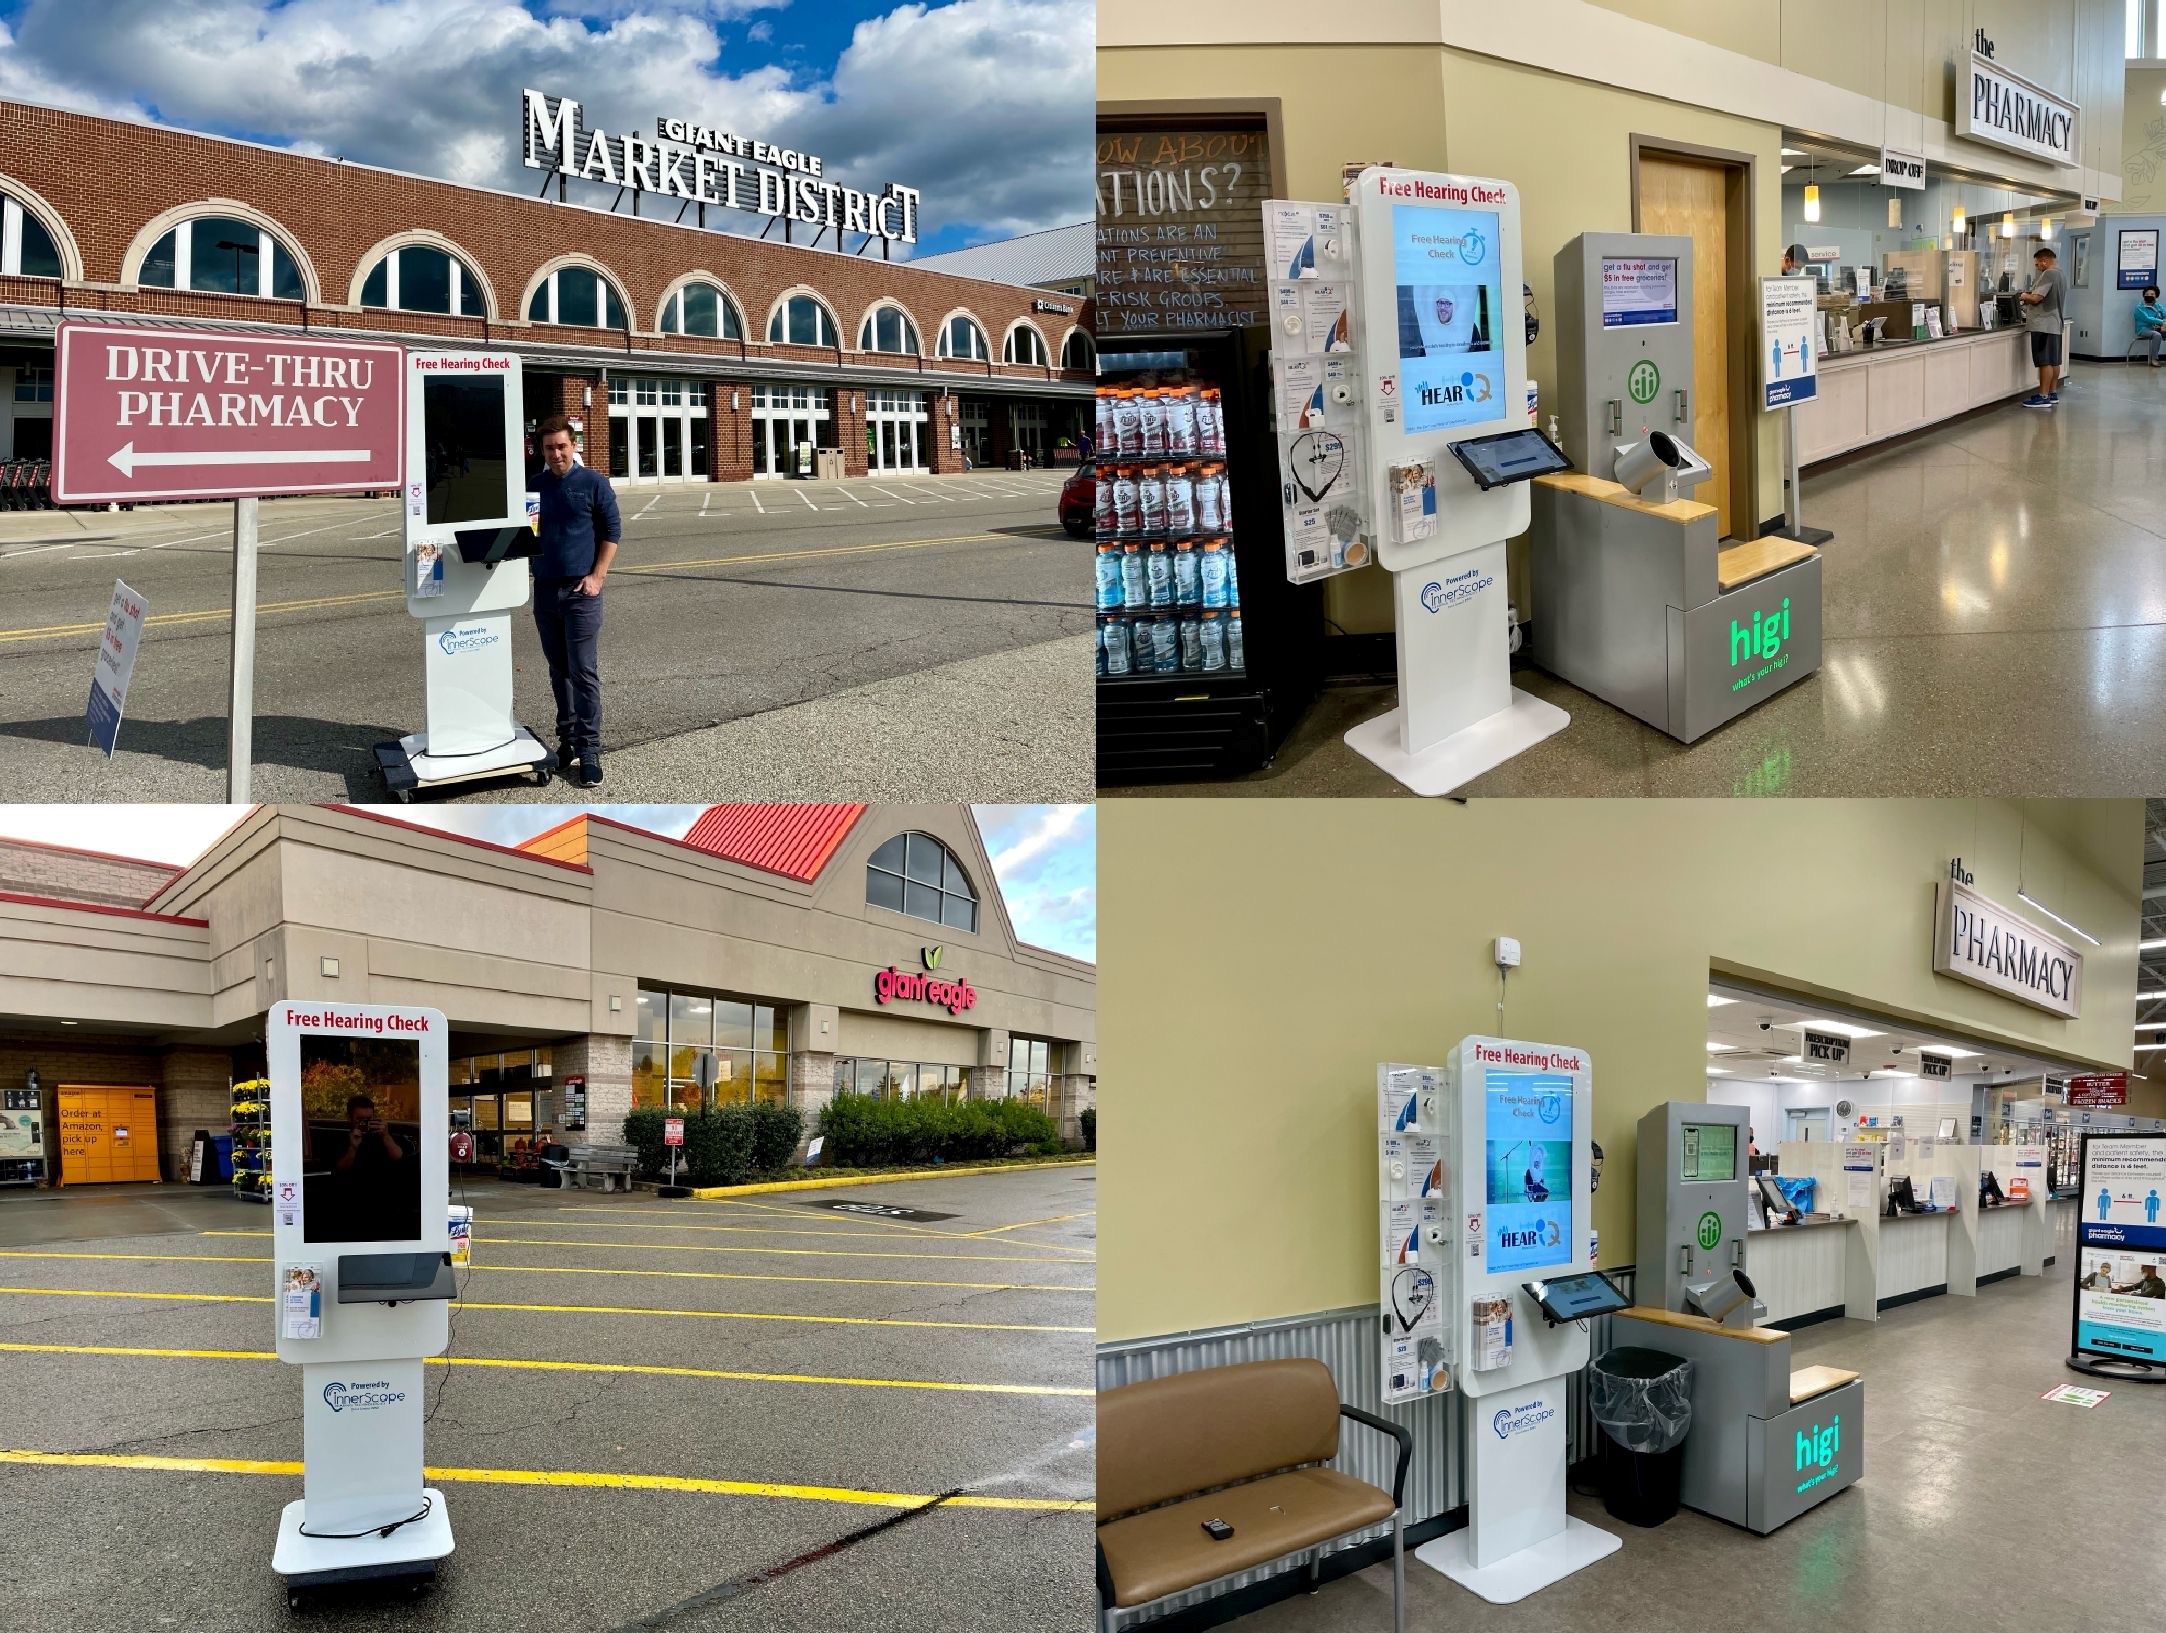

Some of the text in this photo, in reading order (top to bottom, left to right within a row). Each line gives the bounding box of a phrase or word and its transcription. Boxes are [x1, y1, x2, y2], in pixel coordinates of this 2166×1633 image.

[1975, 28, 1994, 60] the
[1973, 73, 2072, 152] PHARMACY
[666, 118, 821, 177] GIANT EAGLE
[523, 88, 920, 243] MARKET DISTRICT
[1885, 158, 1923, 178] DROP OFF
[1379, 176, 1507, 205] Free Hearing Check
[1157, 225, 1189, 241] ARE
[1193, 223, 1217, 240] AN
[1411, 234, 1467, 246] Free Hearing
[1127, 247, 1224, 263] PREVENTIVE
[1428, 249, 1455, 258] Check
[1144, 269, 1175, 283] ARE
[1181, 267, 1261, 284] ESSENTIAL
[1603, 263, 1615, 272] get
[1661, 264, 1672, 272] get
[1604, 274, 1612, 283] $5
[1121, 310, 1159, 326] YOUR
[1166, 309, 1259, 327] PHARMACIST
[105, 345, 374, 390] DRIVE-THRU
[416, 358, 511, 372] Free Hearing Check
[1421, 385, 1463, 405] HEAR
[116, 391, 366, 427] PHARMACY
[1446, 569, 1479, 585] Powered by
[1431, 576, 1493, 606] innerScope
[1731, 597, 1790, 667] higi
[1731, 653, 1789, 692] what's your higi?
[1950, 857, 1974, 885] the
[1953, 905, 2073, 1001] PHARMACY
[877, 965, 976, 1015] giant eagle
[286, 1009, 429, 1033] Free Hearing Check
[1805, 1032, 1850, 1049] PRESCRIPTION
[1476, 1044, 1580, 1071] Free Hearing Check
[1810, 1043, 1845, 1061] PICK UP
[1923, 1063, 1947, 1076] PICK UP
[1500, 1094, 1545, 1107] Free Hearing
[61, 1109, 101, 1118] Order at
[1512, 1108, 1535, 1117] Check
[62, 1122, 102, 1131] Amazon,
[62, 1134, 97, 1144] pick up
[1501, 1230, 1537, 1248] HEAR
[2088, 1232, 2125, 1241] pharmacy
[351, 1381, 389, 1390] Powered by
[1515, 1400, 1543, 1413] Powered by
[1796, 1414, 1839, 1472] higi
